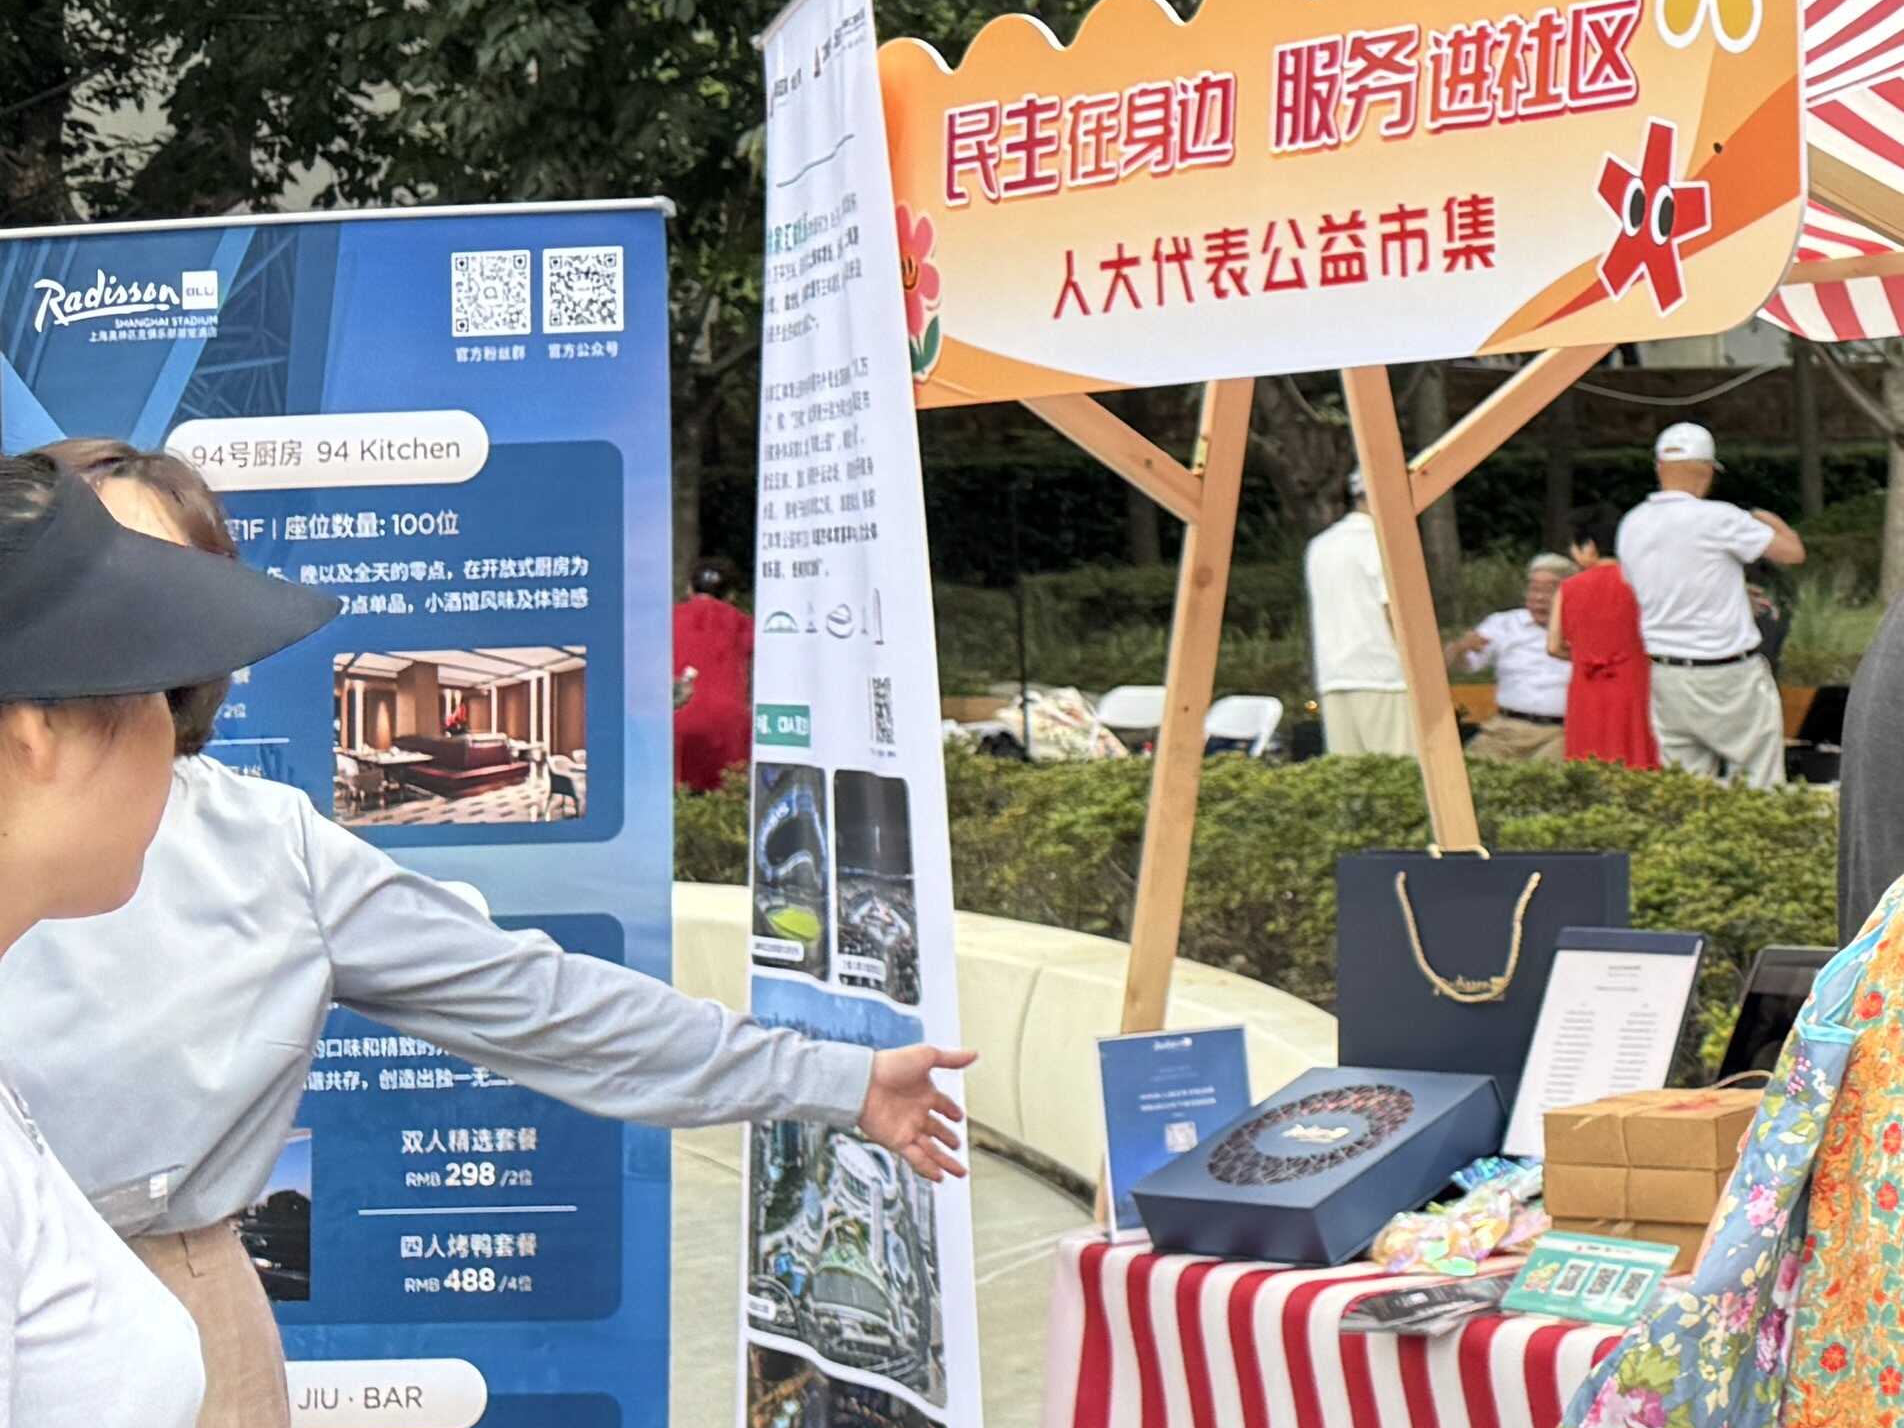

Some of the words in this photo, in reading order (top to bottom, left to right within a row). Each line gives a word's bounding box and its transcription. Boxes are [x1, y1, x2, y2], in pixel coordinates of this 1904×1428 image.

[942, 72, 1236, 208] 民主在身边
[1051, 194, 1497, 319] 人大代表公益市集
[34, 269, 180, 332] Radisson
[192, 439, 303, 469] 94号厨房
[317, 440, 350, 463] 94
[360, 438, 462, 461] Kitchen
[401, 1127, 537, 1154] 双人精选套餐
[445, 1162, 496, 1187] 298
[443, 1267, 496, 1292] 488
[297, 1387, 339, 1411] JIU
[363, 1385, 423, 1410] BAR
